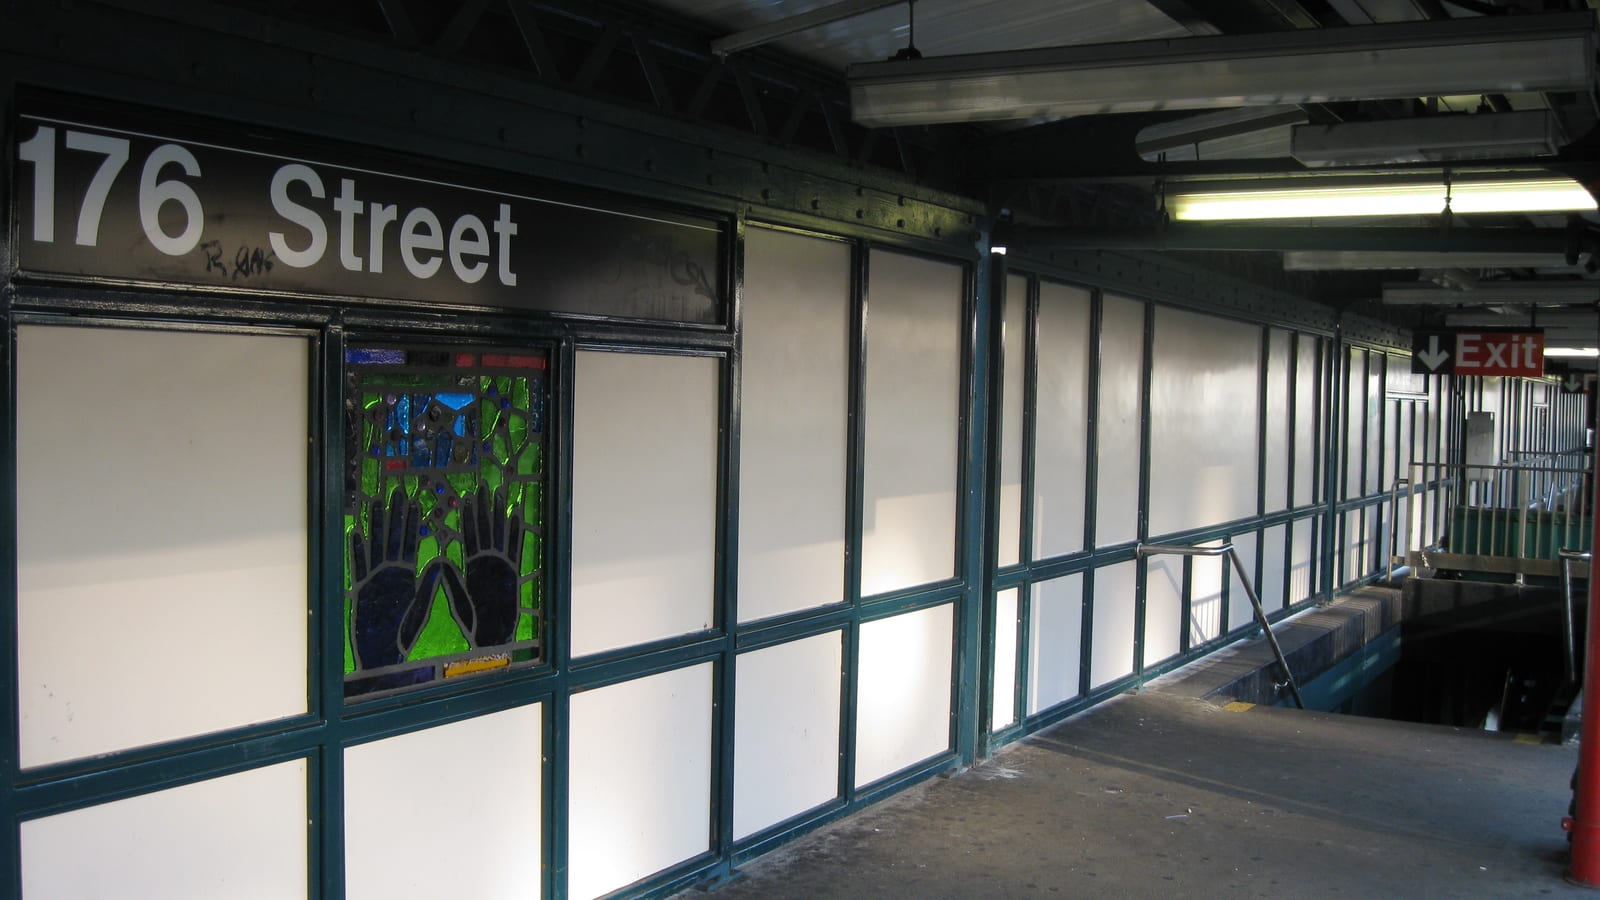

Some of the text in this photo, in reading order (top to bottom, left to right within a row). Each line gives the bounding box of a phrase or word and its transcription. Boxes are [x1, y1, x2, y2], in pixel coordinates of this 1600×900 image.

[19, 126, 205, 256] 176
[268, 164, 518, 286] Street
[1456, 333, 1537, 369] Exit
